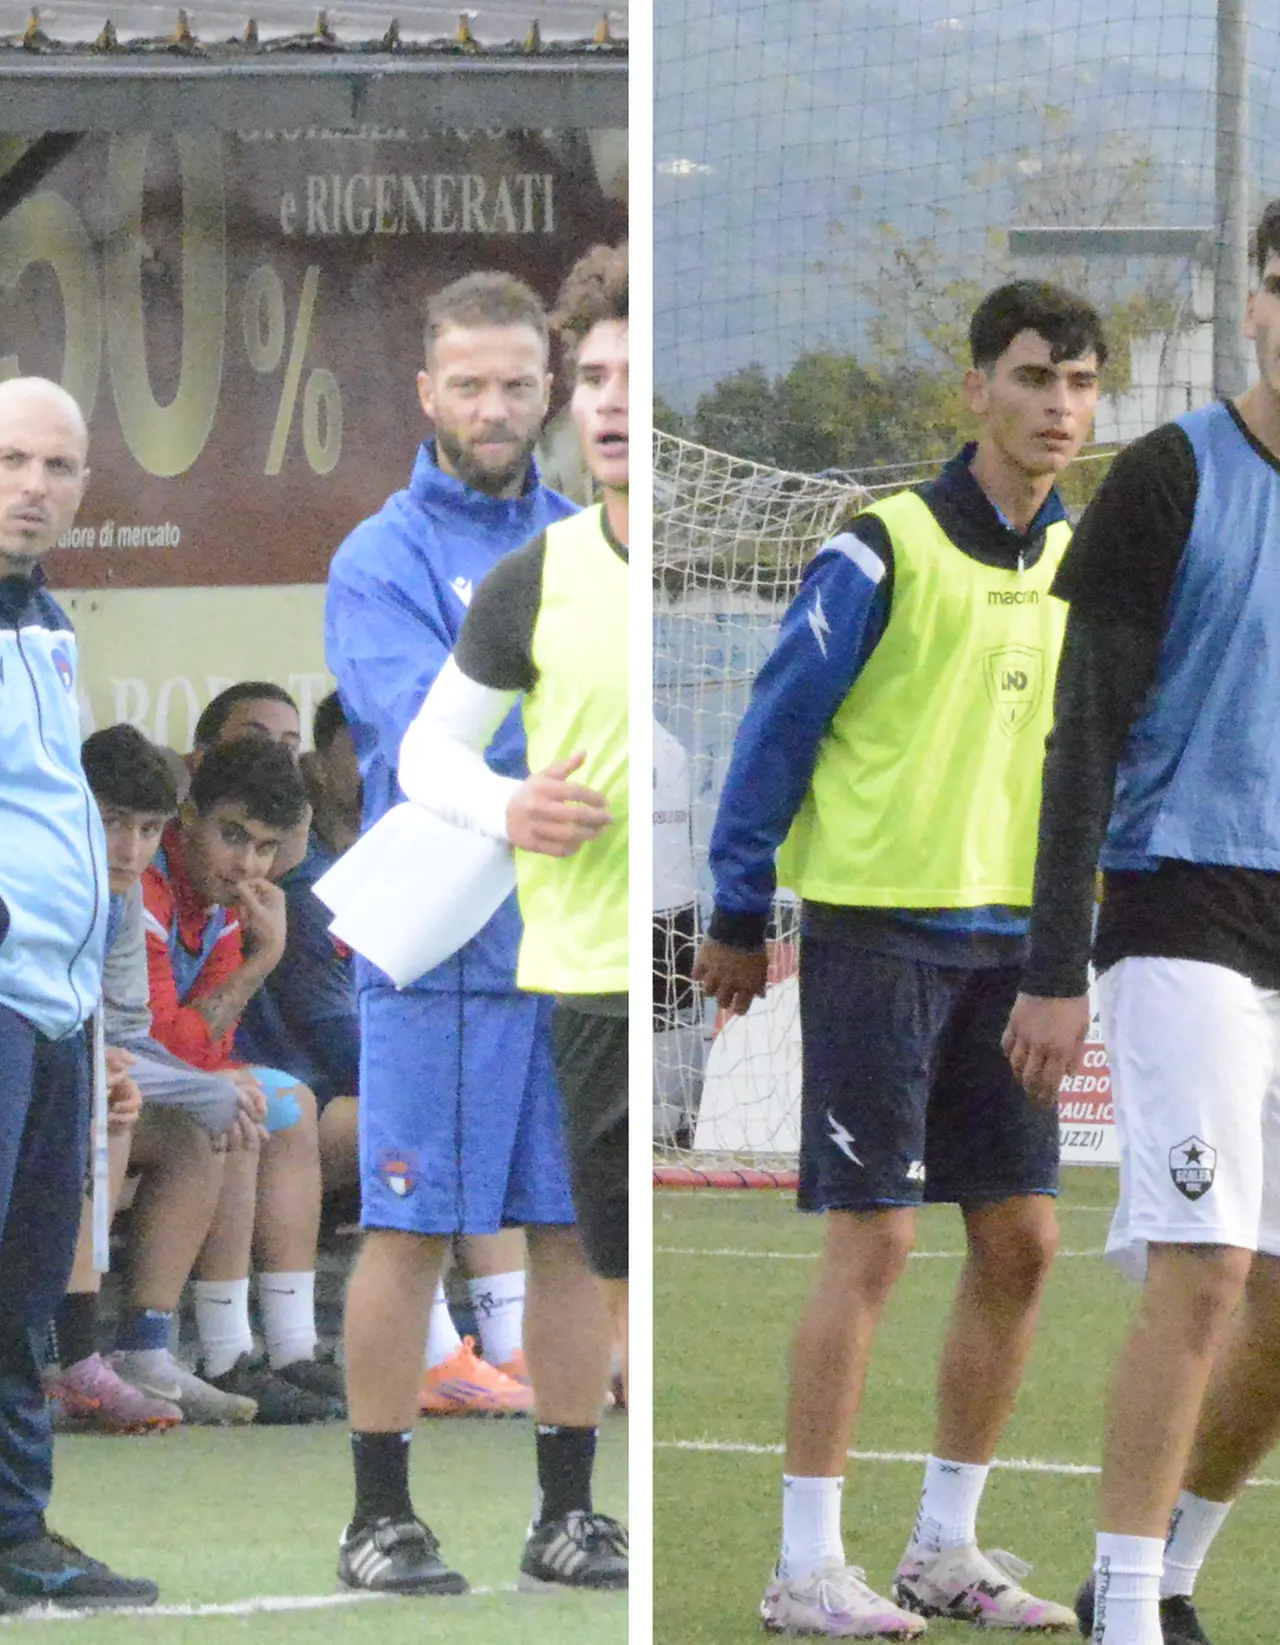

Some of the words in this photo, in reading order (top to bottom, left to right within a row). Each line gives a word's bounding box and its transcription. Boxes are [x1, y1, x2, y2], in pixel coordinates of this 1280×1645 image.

[280, 191, 297, 235] e
[306, 173, 555, 235] RIGENERATI
[52, 526, 96, 548] alore
[99, 519, 115, 548] di
[118, 521, 181, 548] mercato
[1059, 1075, 1110, 1093] REDO
[1059, 1102, 1114, 1120] AULIC
[1059, 1130, 1104, 1151] UZZI)
